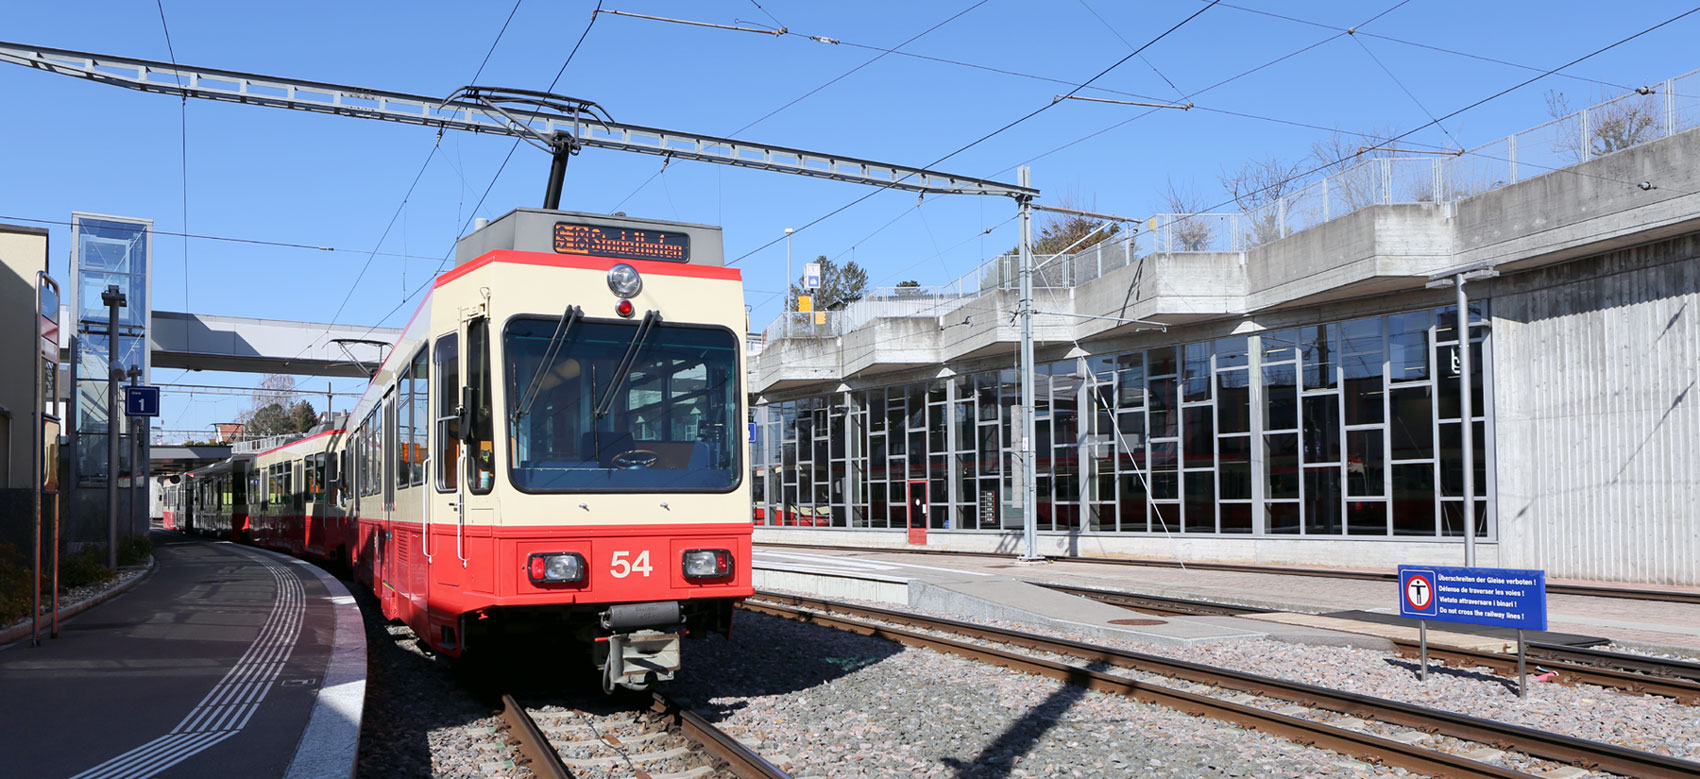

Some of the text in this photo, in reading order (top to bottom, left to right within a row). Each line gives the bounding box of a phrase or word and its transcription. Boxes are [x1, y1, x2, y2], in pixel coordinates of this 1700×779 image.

[591, 228, 683, 258] Stadelhofen
[138, 398, 145, 411] 1
[610, 550, 653, 578] 54
[1438, 573, 1475, 583] Überschreiten
[1476, 576, 1485, 584] der
[1506, 578, 1532, 586] verboten
[1438, 585, 1459, 593] Défense
[1469, 587, 1494, 595] traverser
[1459, 597, 1492, 606] attraversare
[1440, 606, 1447, 614] Do
[1474, 609, 1483, 617] the
[1484, 610, 1505, 619] railway
[1506, 612, 1521, 620] lines
